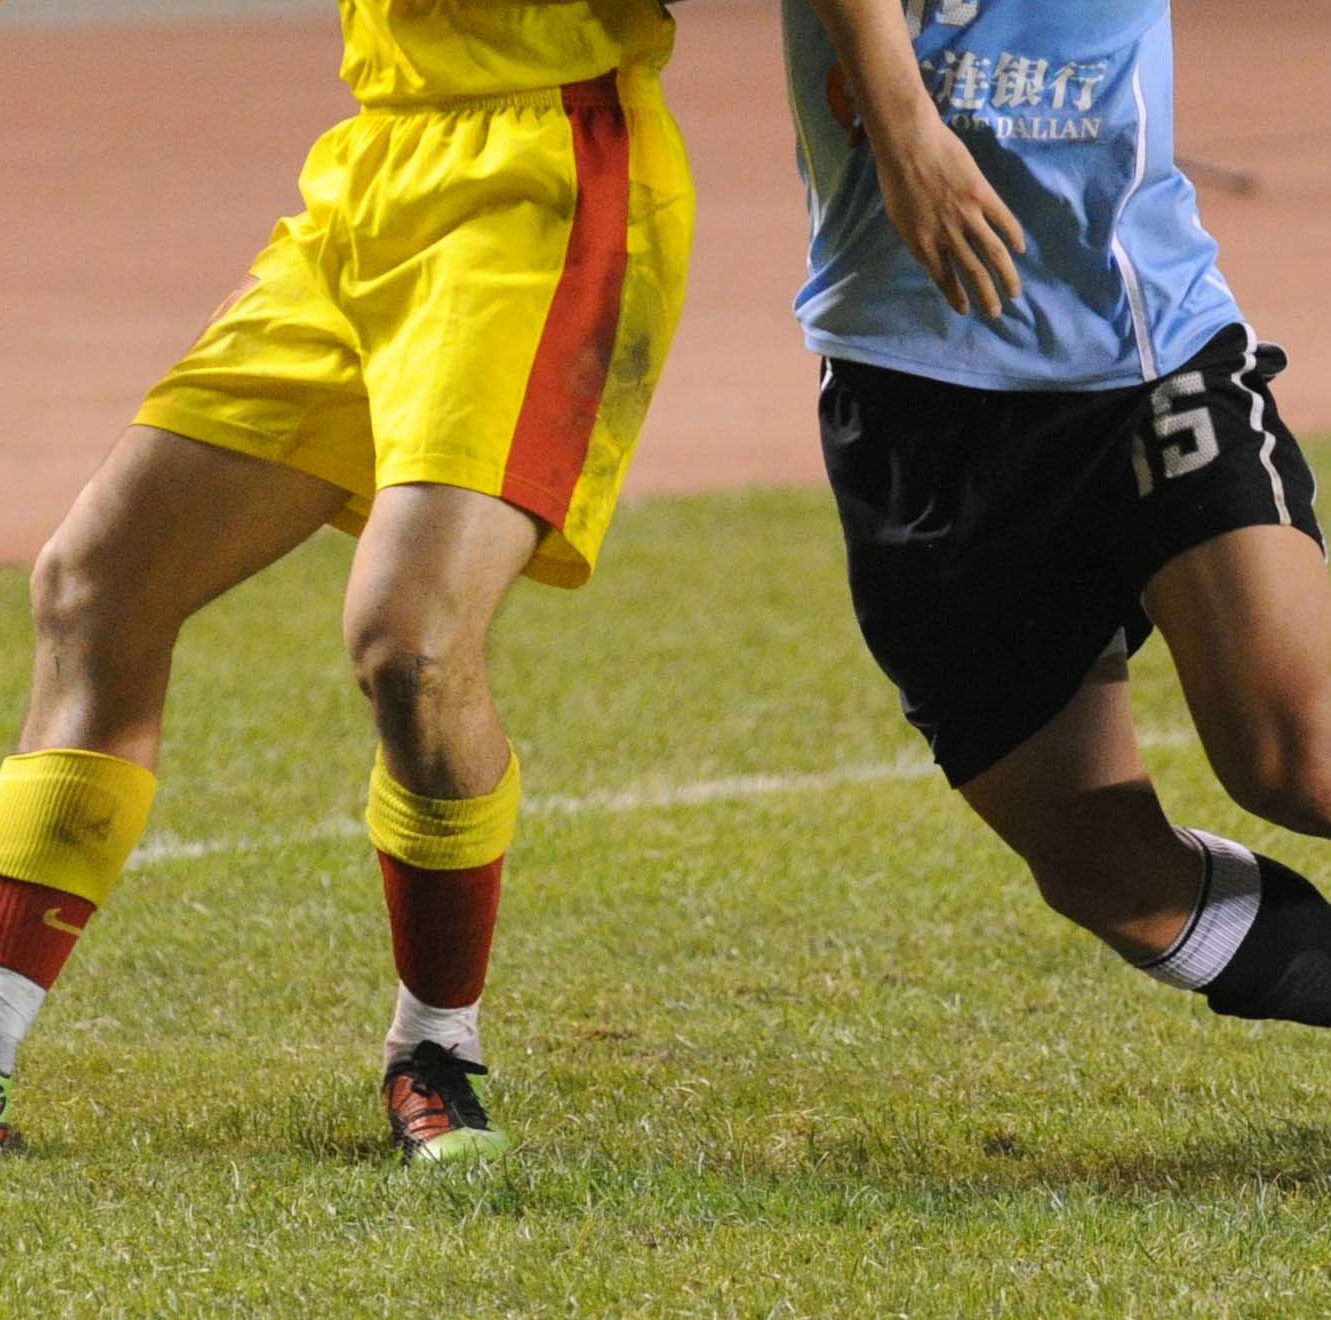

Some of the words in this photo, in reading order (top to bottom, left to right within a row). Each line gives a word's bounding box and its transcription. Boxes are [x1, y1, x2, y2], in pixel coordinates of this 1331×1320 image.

[922, 50, 1107, 111] 连银行
[996, 115, 1102, 139] DALIAN
